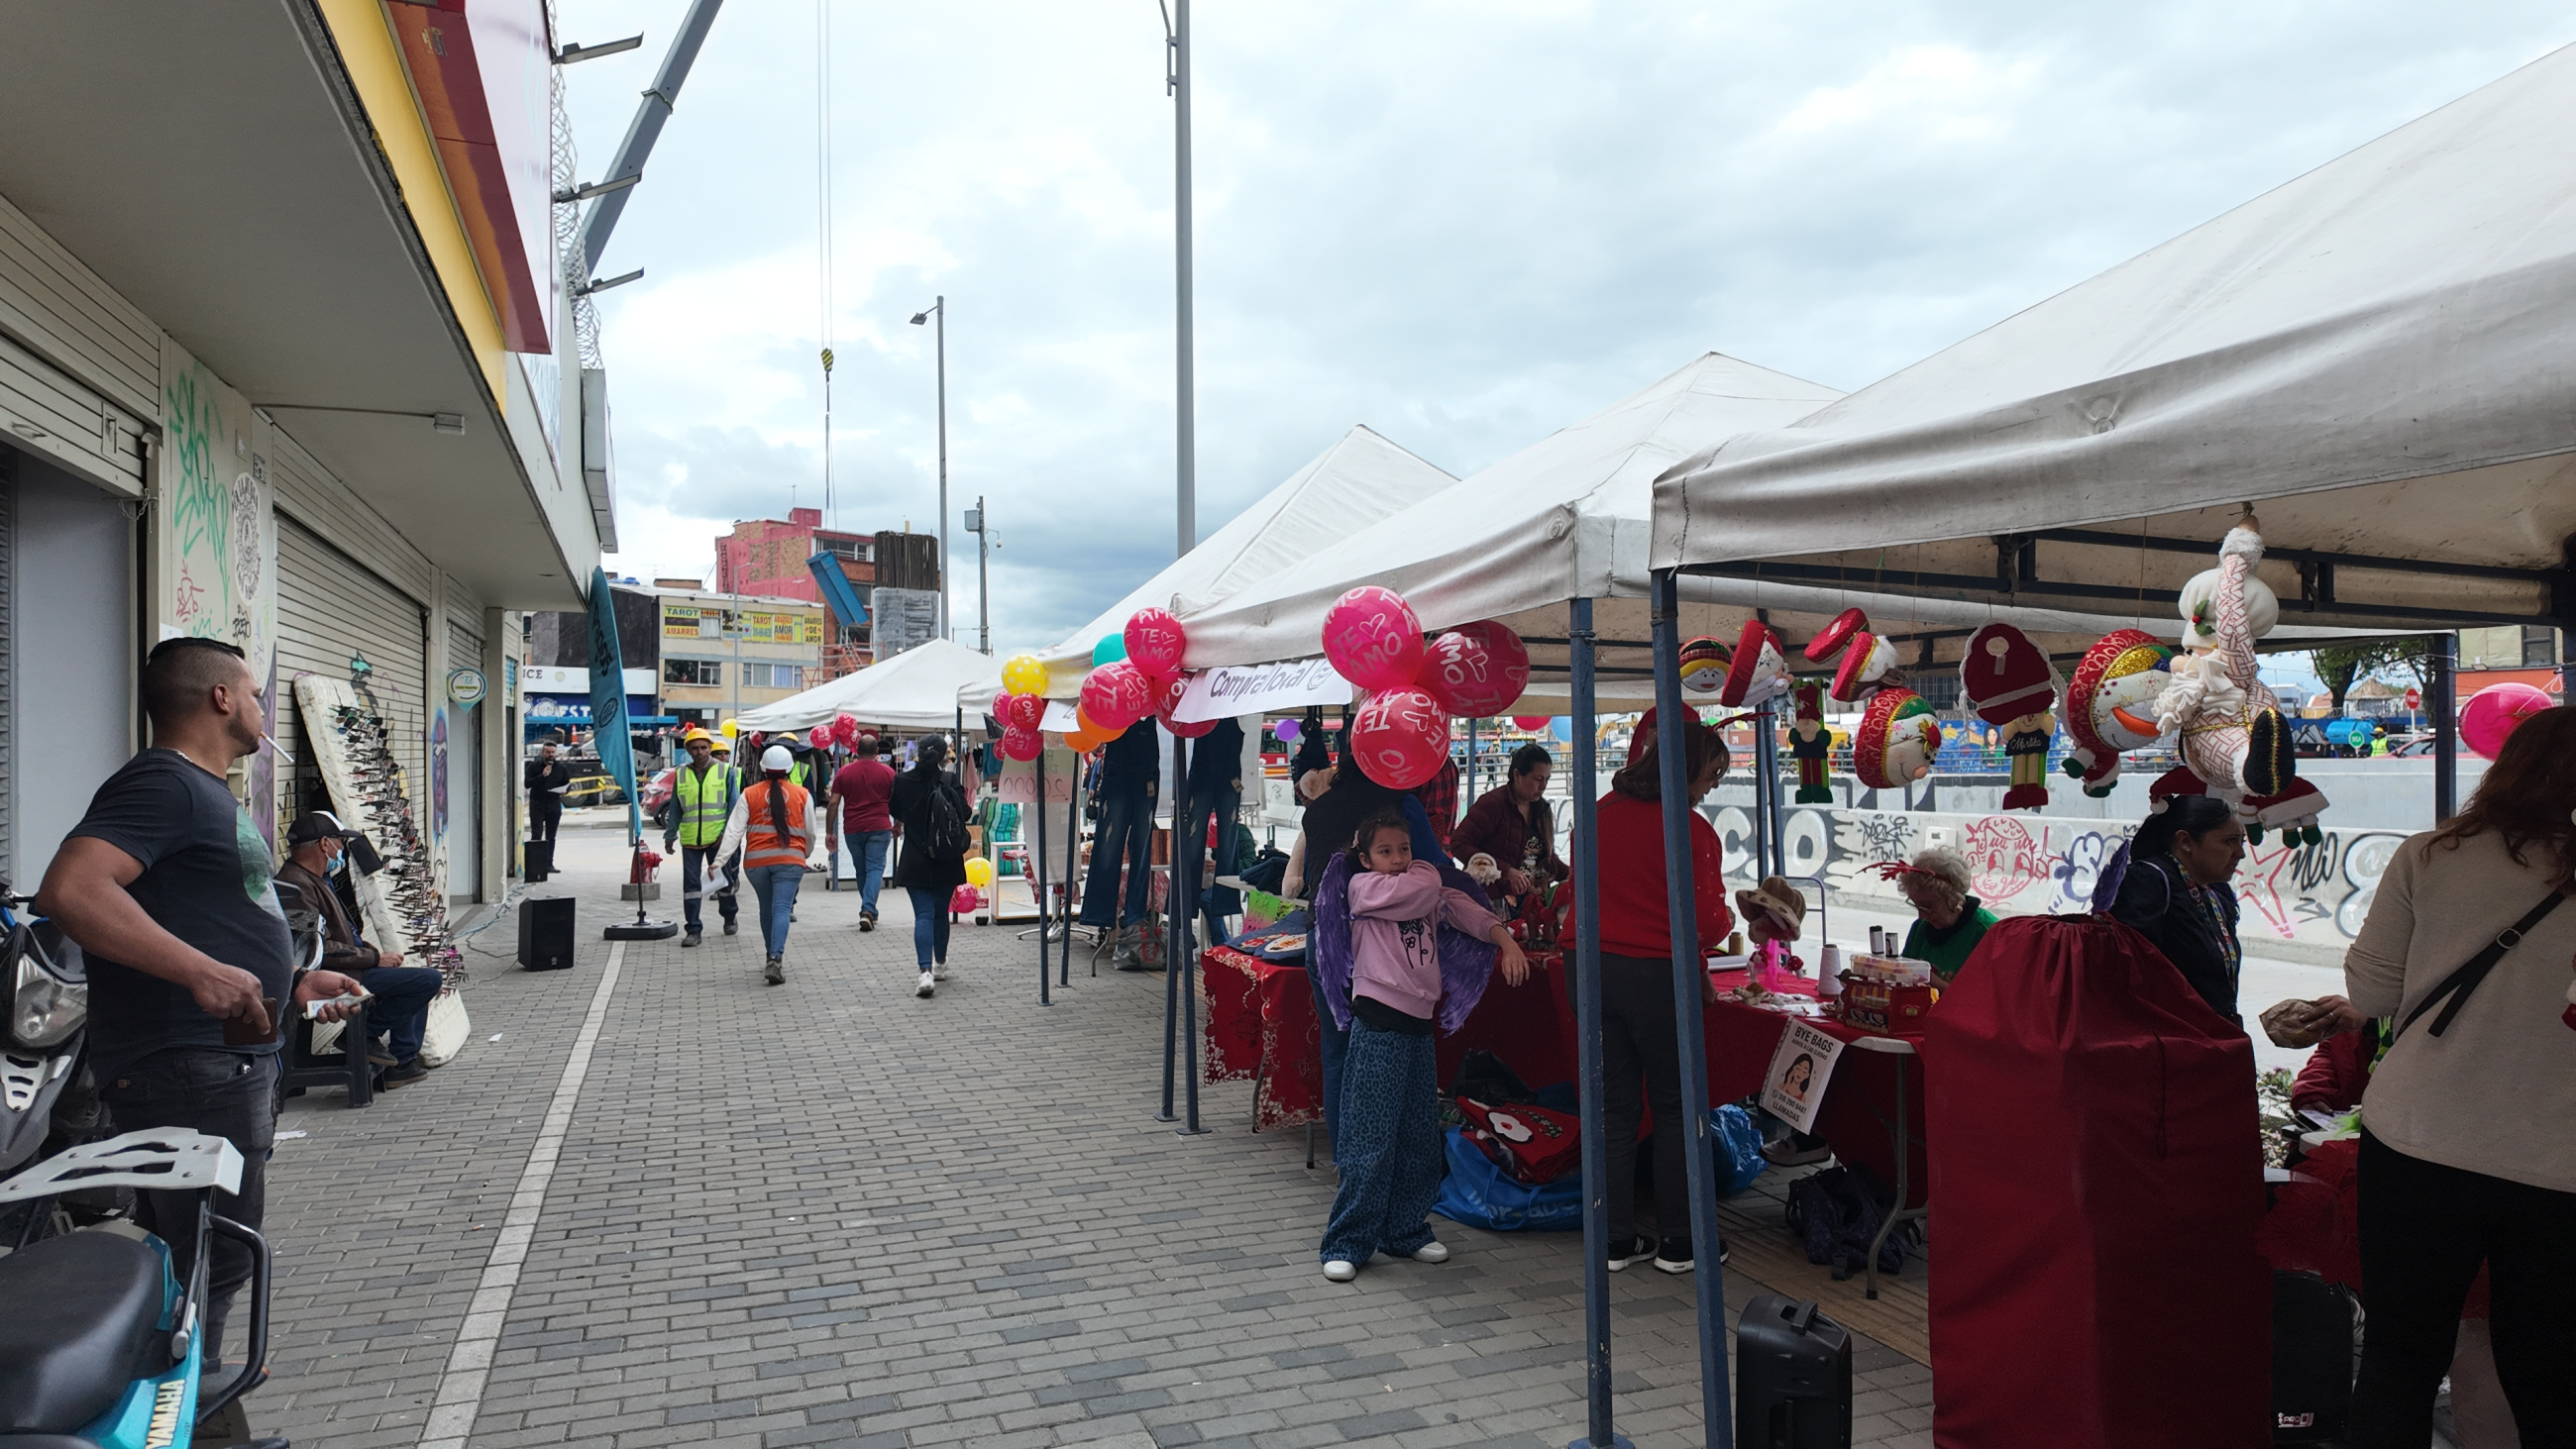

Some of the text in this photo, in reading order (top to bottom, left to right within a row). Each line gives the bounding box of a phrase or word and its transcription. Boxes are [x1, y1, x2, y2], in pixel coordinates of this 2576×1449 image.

[666, 607, 699, 617] TAROT
[666, 627, 699, 637] AMARRES
[774, 625, 793, 635] AMOR
[1139, 628, 1159, 644] TE
[1137, 645, 1174, 661] AMO
[1348, 631, 1403, 678] AMO
[1210, 670, 1267, 703] Compra
[1263, 665, 1312, 693] local
[2407, 694, 2417, 703] PARE
[1363, 706, 1391, 734] TE
[1795, 1026, 1834, 1053] BYE BAGS
[1772, 1100, 1800, 1123] LLAMADAS
[145, 1379, 186, 1449] YAMAHA
